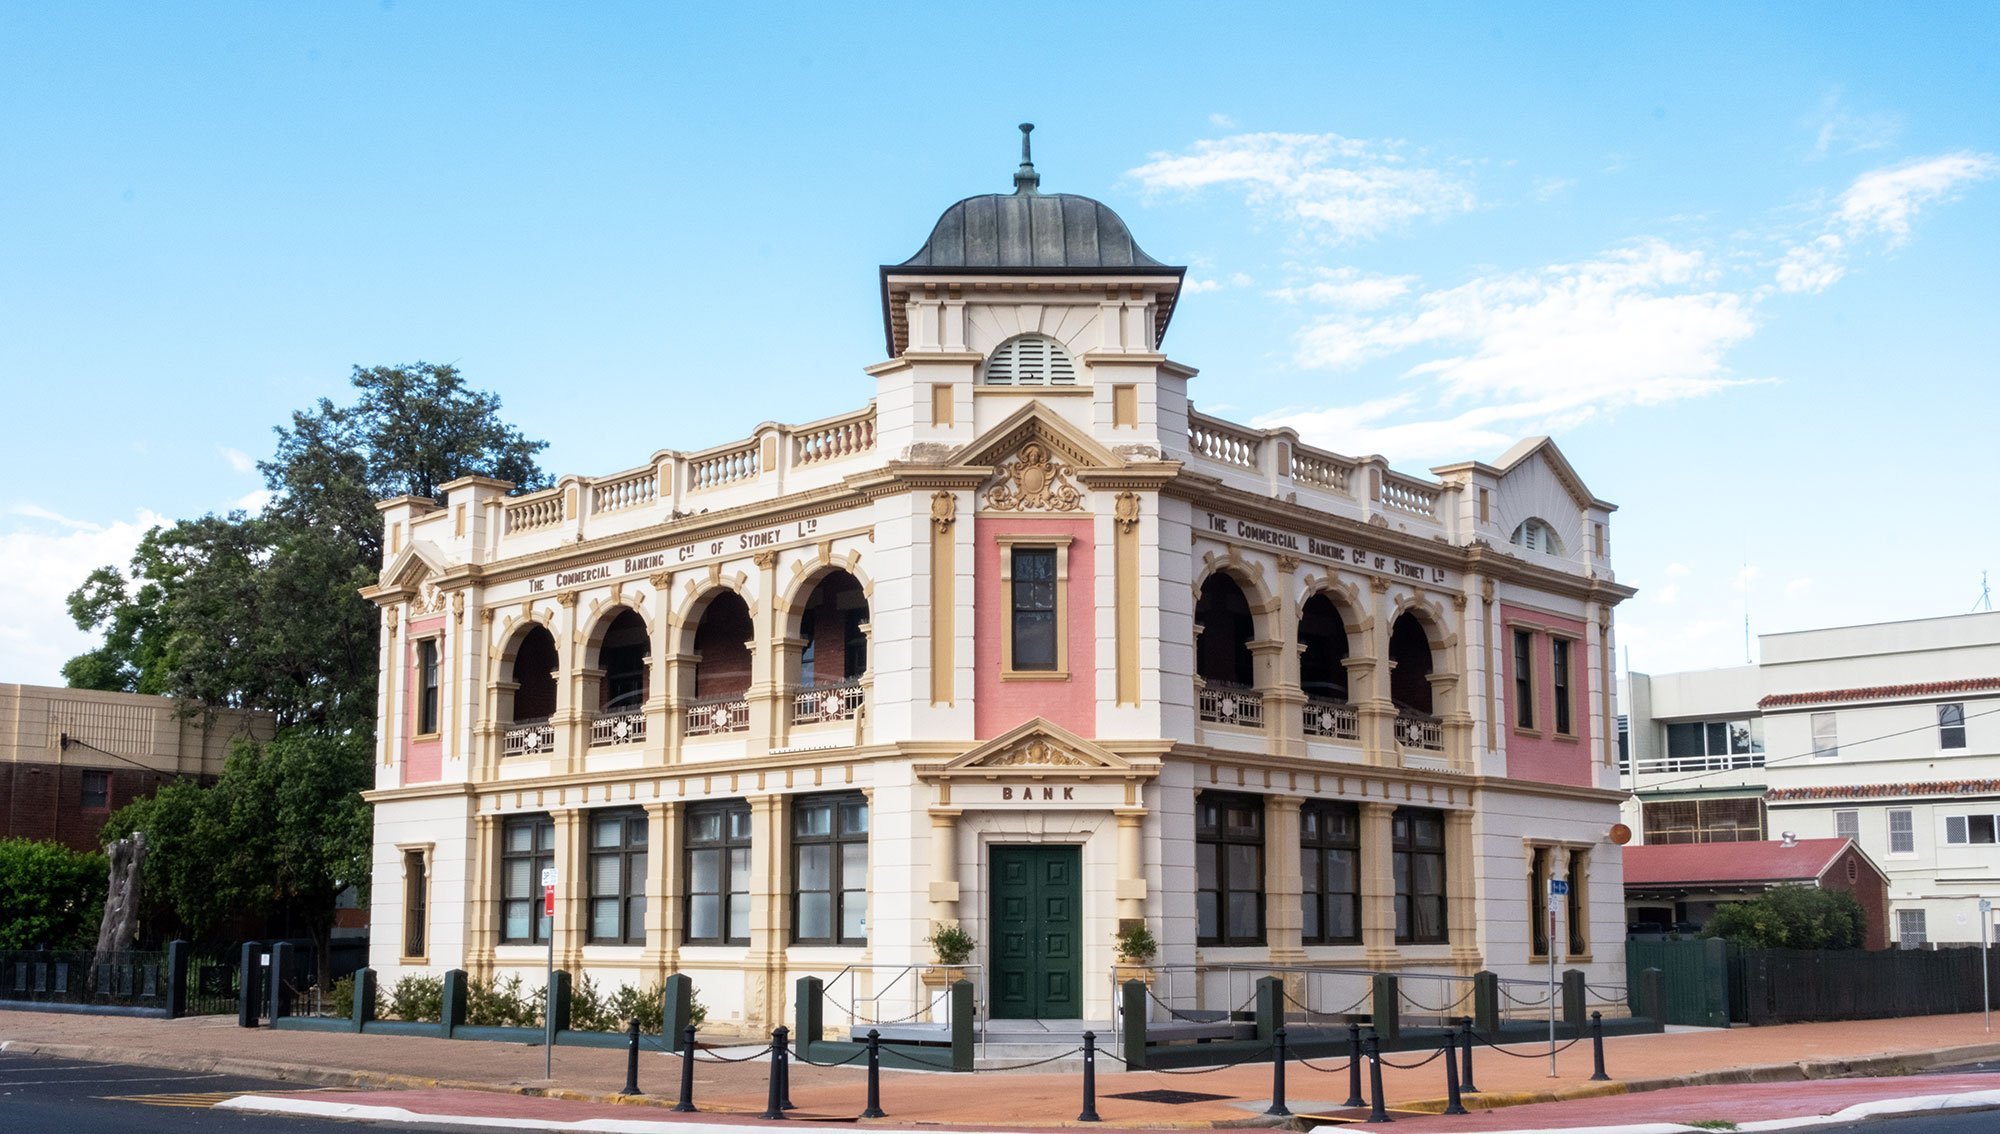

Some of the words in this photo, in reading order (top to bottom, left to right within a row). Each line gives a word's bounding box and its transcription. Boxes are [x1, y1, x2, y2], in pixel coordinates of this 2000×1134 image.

[529, 579, 545, 593] THE
[556, 566, 611, 587] COMMERCIAL
[625, 554, 664, 573] BANKING
[711, 541, 724, 555] OF
[740, 529, 781, 549] SYDNEY
[798, 519, 818, 538] LTD
[1207, 513, 1227, 533] THE
[1237, 521, 1299, 550] COMMERCIAL
[1308, 537, 1345, 560] BANKING
[1374, 556, 1386, 570] OF
[1394, 559, 1424, 580] SYDNEY
[1002, 787, 1074, 800] BANK
